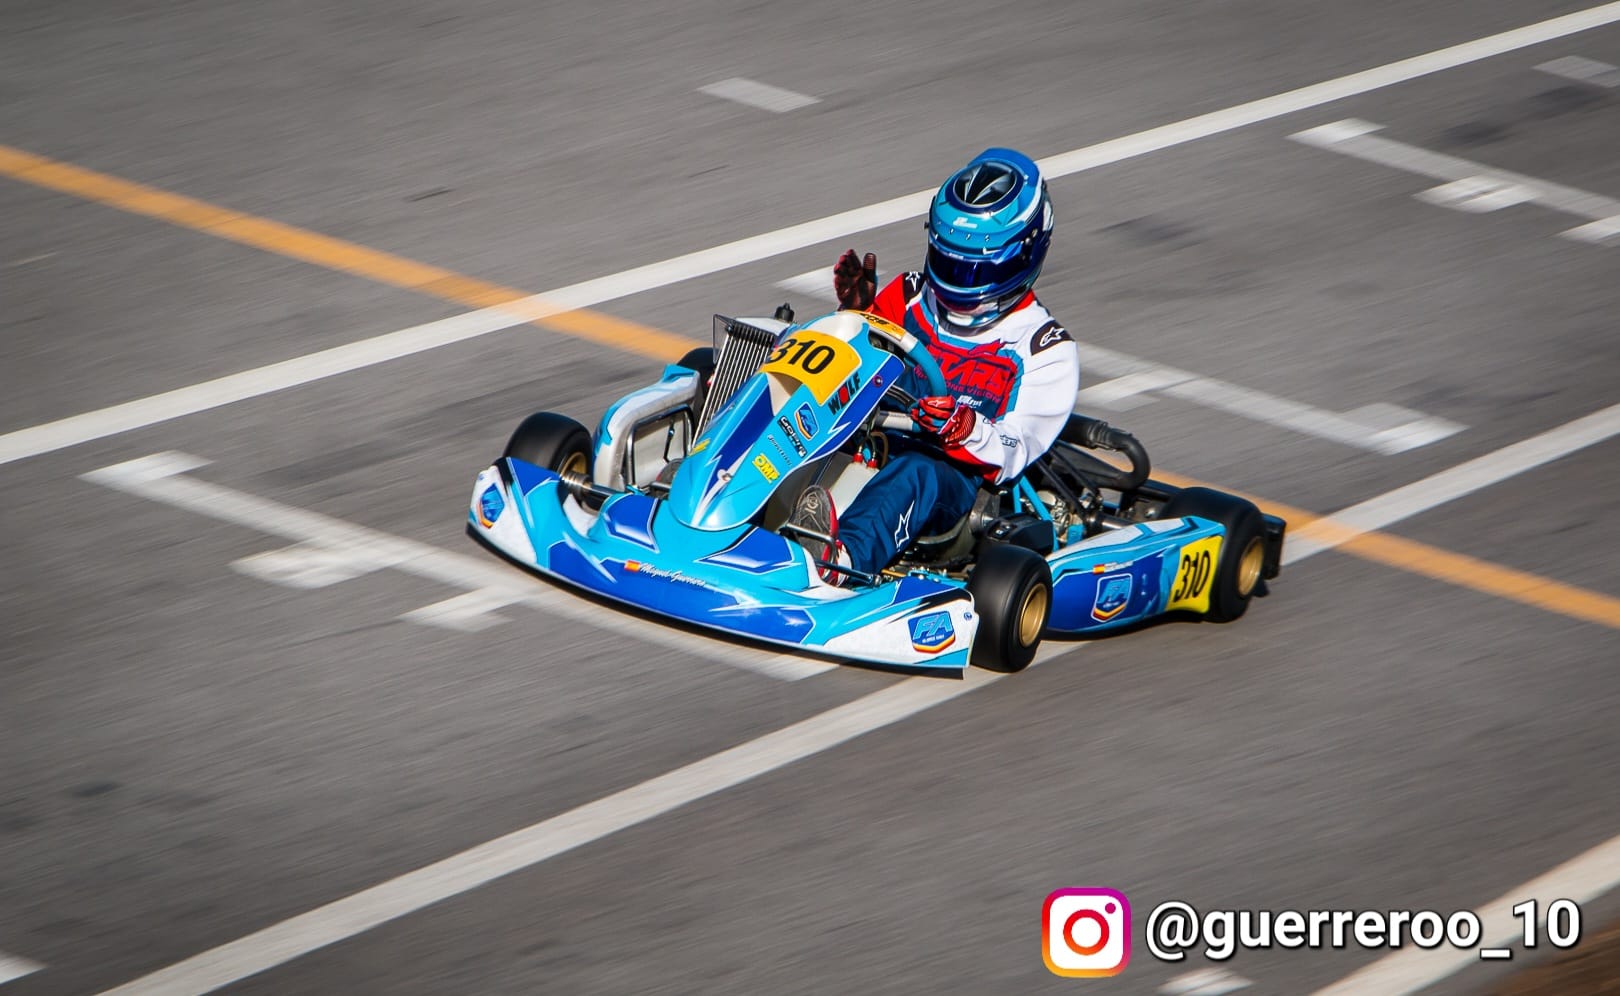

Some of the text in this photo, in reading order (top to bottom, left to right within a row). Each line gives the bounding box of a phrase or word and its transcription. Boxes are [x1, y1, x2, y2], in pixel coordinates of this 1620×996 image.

[765, 338, 836, 375] 310
[828, 372, 861, 415] WOLF
[753, 455, 780, 482] OMP
[1172, 550, 1211, 603] 310
[912, 611, 954, 641] FA
